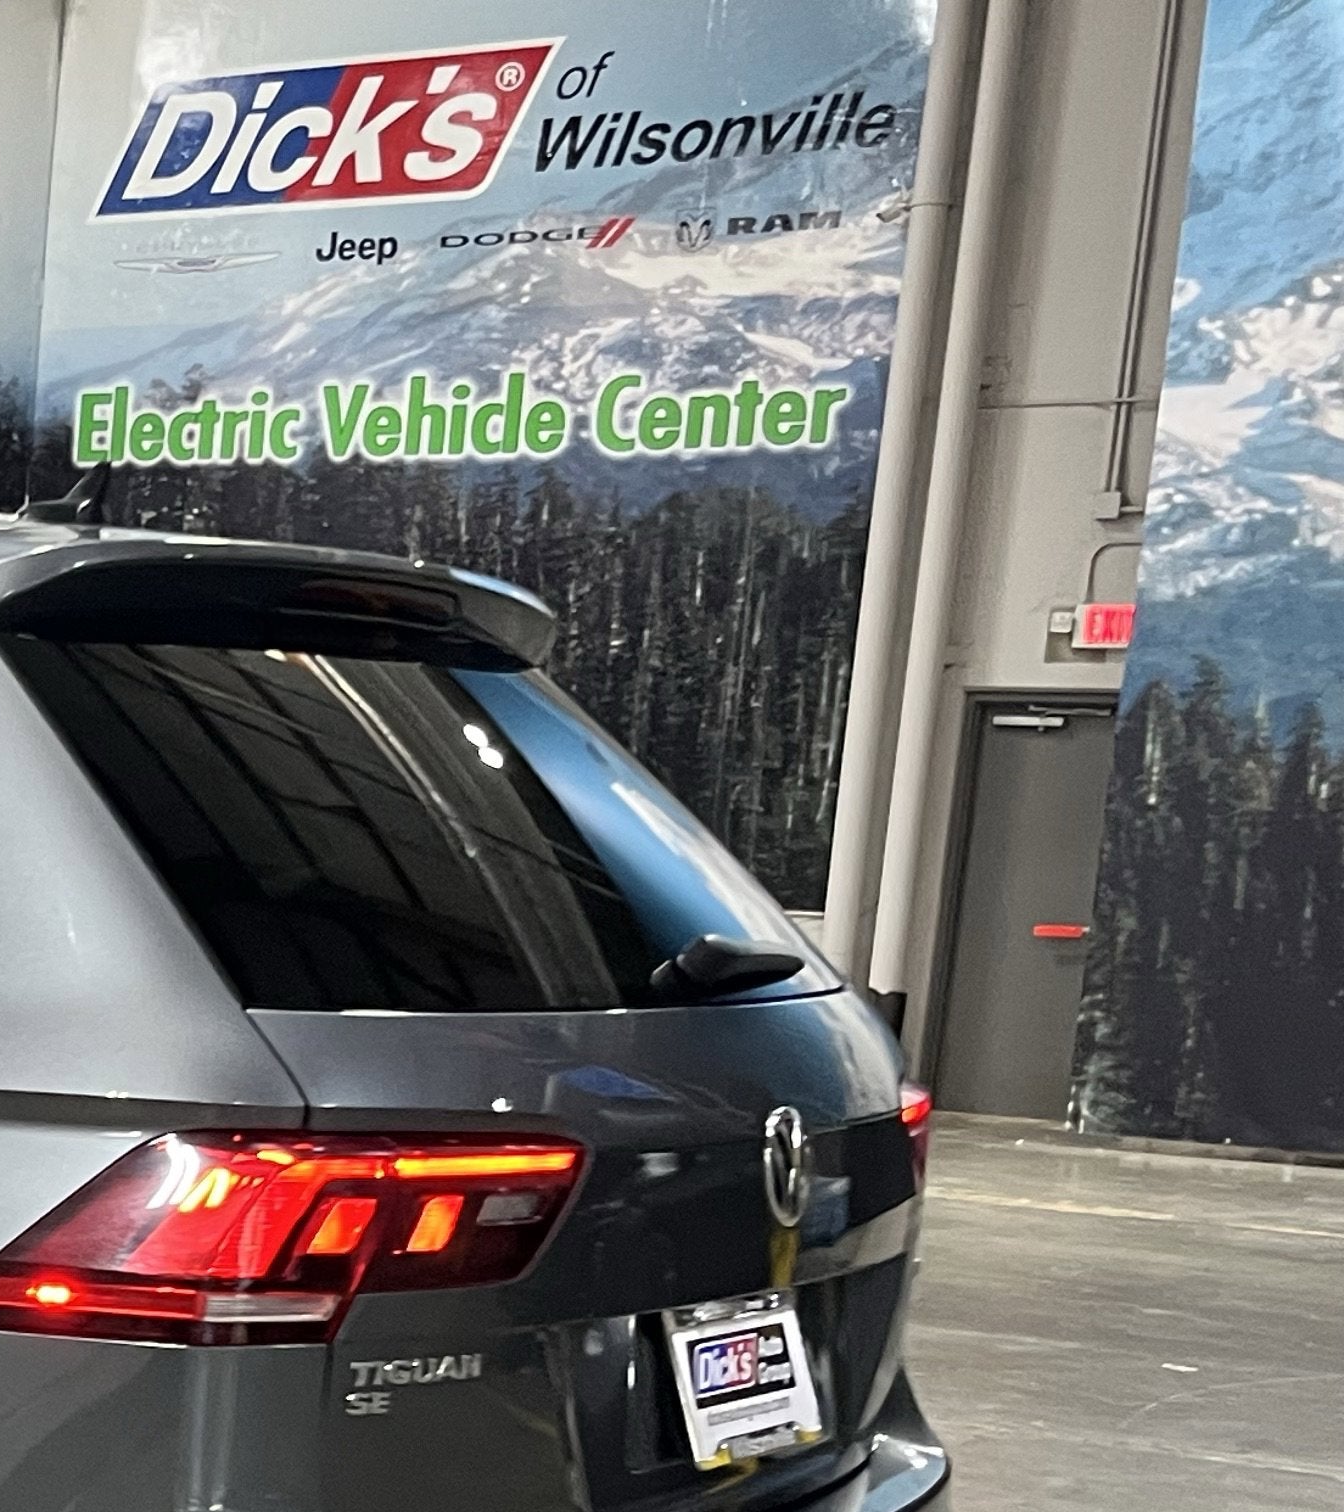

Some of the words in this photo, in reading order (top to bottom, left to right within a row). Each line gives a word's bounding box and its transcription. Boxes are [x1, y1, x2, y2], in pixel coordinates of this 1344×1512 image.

[556, 51, 615, 100] of
[121, 64, 498, 201] Dick's
[535, 90, 897, 173] Wilsonville
[315, 231, 398, 265] Jeep
[440, 224, 603, 249] DODGE
[727, 210, 843, 236] RAM
[77, 385, 301, 462] Electric
[323, 372, 566, 457] Vehicle
[596, 374, 848, 453] Center
[349, 1353, 482, 1387] TIGUAN
[345, 1391, 392, 1416] SE
